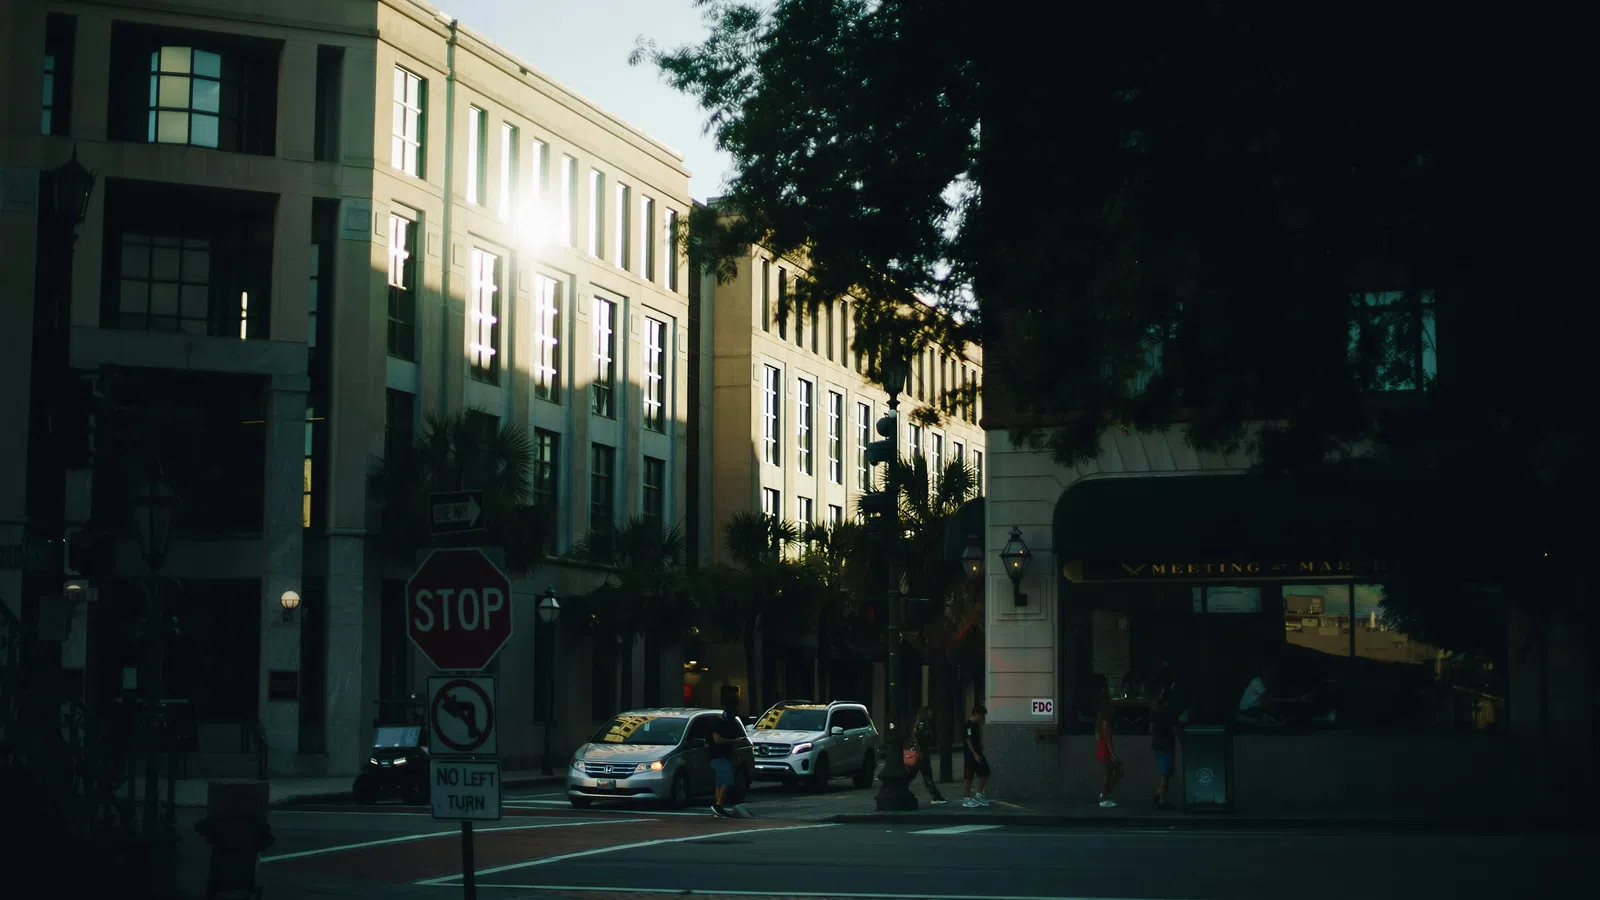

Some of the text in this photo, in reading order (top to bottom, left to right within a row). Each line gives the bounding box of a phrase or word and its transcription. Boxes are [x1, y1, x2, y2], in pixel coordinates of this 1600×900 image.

[434, 503, 468, 521] ONE WAY
[1152, 562, 1261, 575] MEETING
[414, 588, 504, 632] STOP
[1033, 701, 1052, 713] FDC
[437, 768, 496, 786] NO LEFT
[448, 795, 485, 812] TURN
